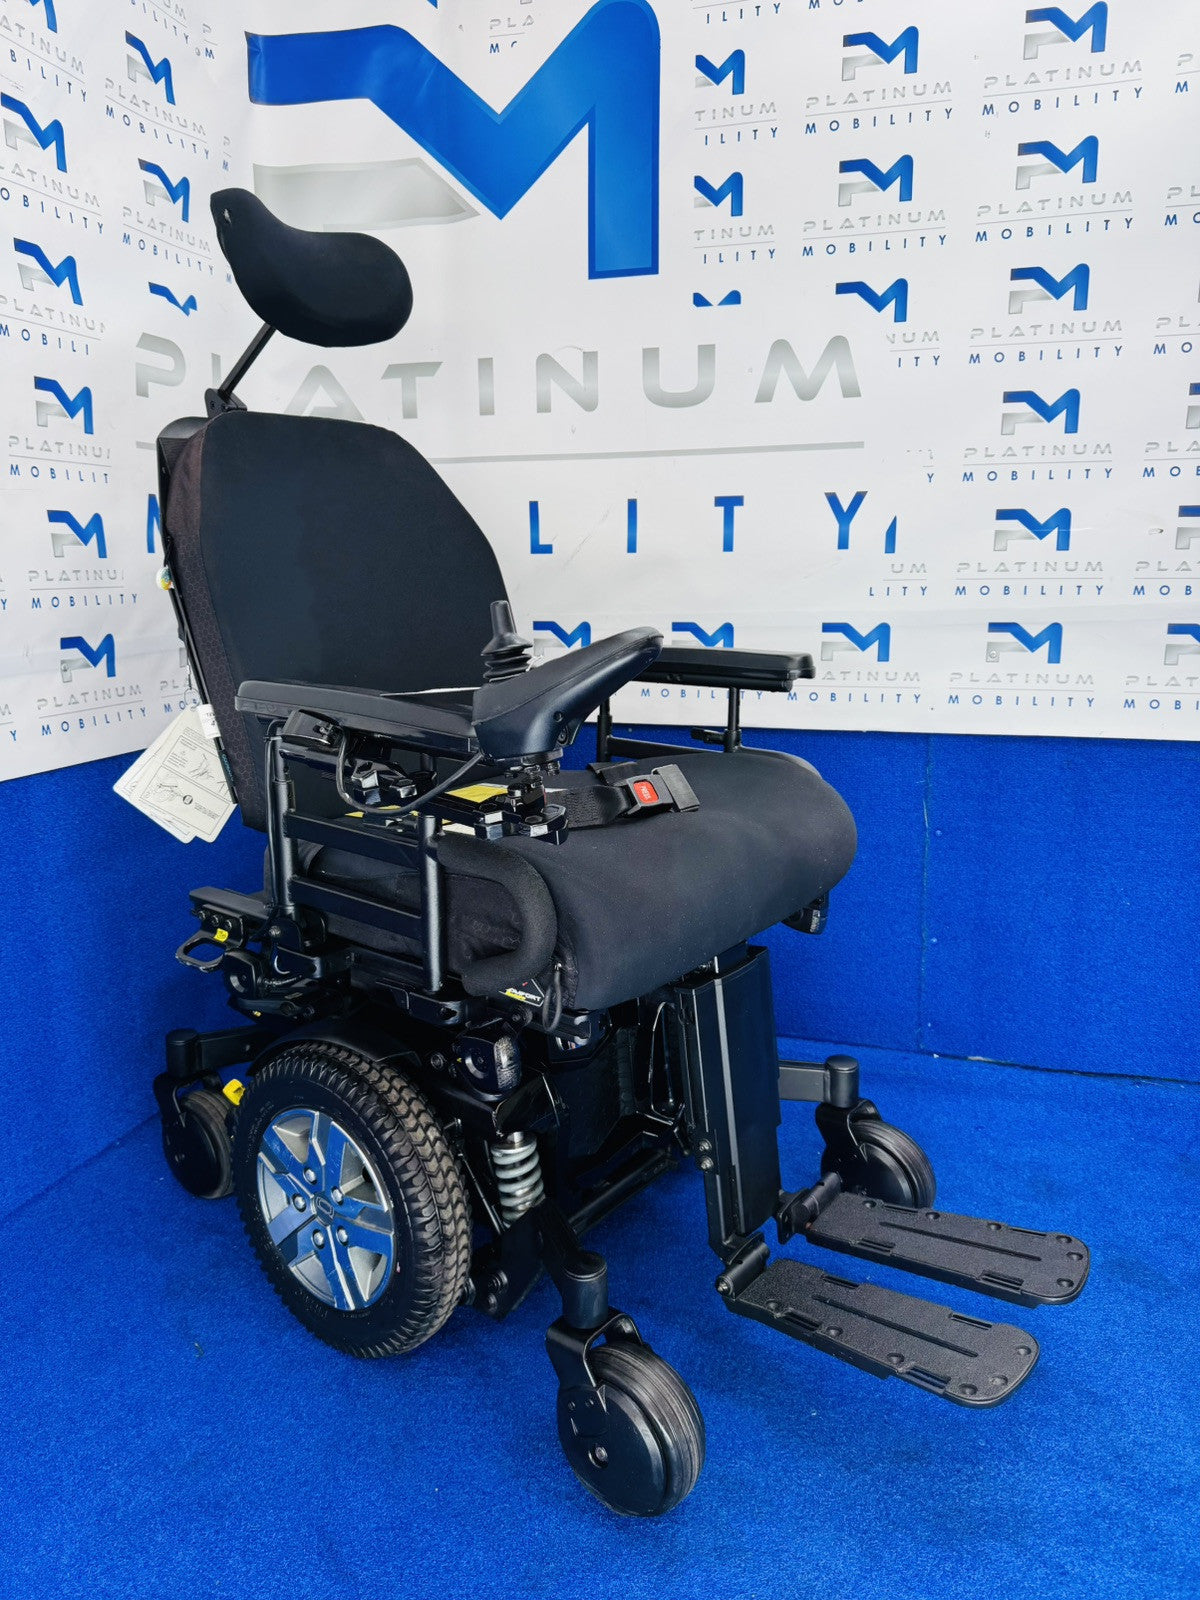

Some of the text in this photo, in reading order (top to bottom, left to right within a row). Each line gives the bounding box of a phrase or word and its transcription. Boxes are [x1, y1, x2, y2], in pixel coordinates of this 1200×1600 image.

[983, 60, 1142, 89] PLATINUM
[104, 77, 206, 136] PLATINUM
[805, 81, 952, 109] PLATINUM
[982, 87, 1142, 116] MOBILITY
[105, 104, 209, 160] MOBILITY
[805, 108, 952, 134] MOBILITY
[976, 191, 1133, 217] PLATINUM
[122, 206, 211, 253] PLATINUM
[803, 209, 946, 232] PLATINUM
[975, 217, 1133, 242] MOBILITY
[122, 232, 214, 276] MOBILITY
[802, 234, 947, 257] MOBILITY
[970, 320, 1122, 340] PLATINUM
[969, 345, 1122, 364] MOBILITY
[963, 443, 1113, 458] PLATINUM
[962, 468, 1113, 482] MOBILITY
[955, 561, 1104, 573] PLATINUM
[31, 593, 138, 609] MOBILITY
[954, 585, 1104, 596] MOBILITY
[949, 672, 1094, 686] PLATINUM
[37, 684, 143, 712] PLATINUM
[787, 691, 921, 704] MOBILITY
[948, 694, 1095, 708] MOBILITY
[41, 707, 146, 737] MOBILITY
